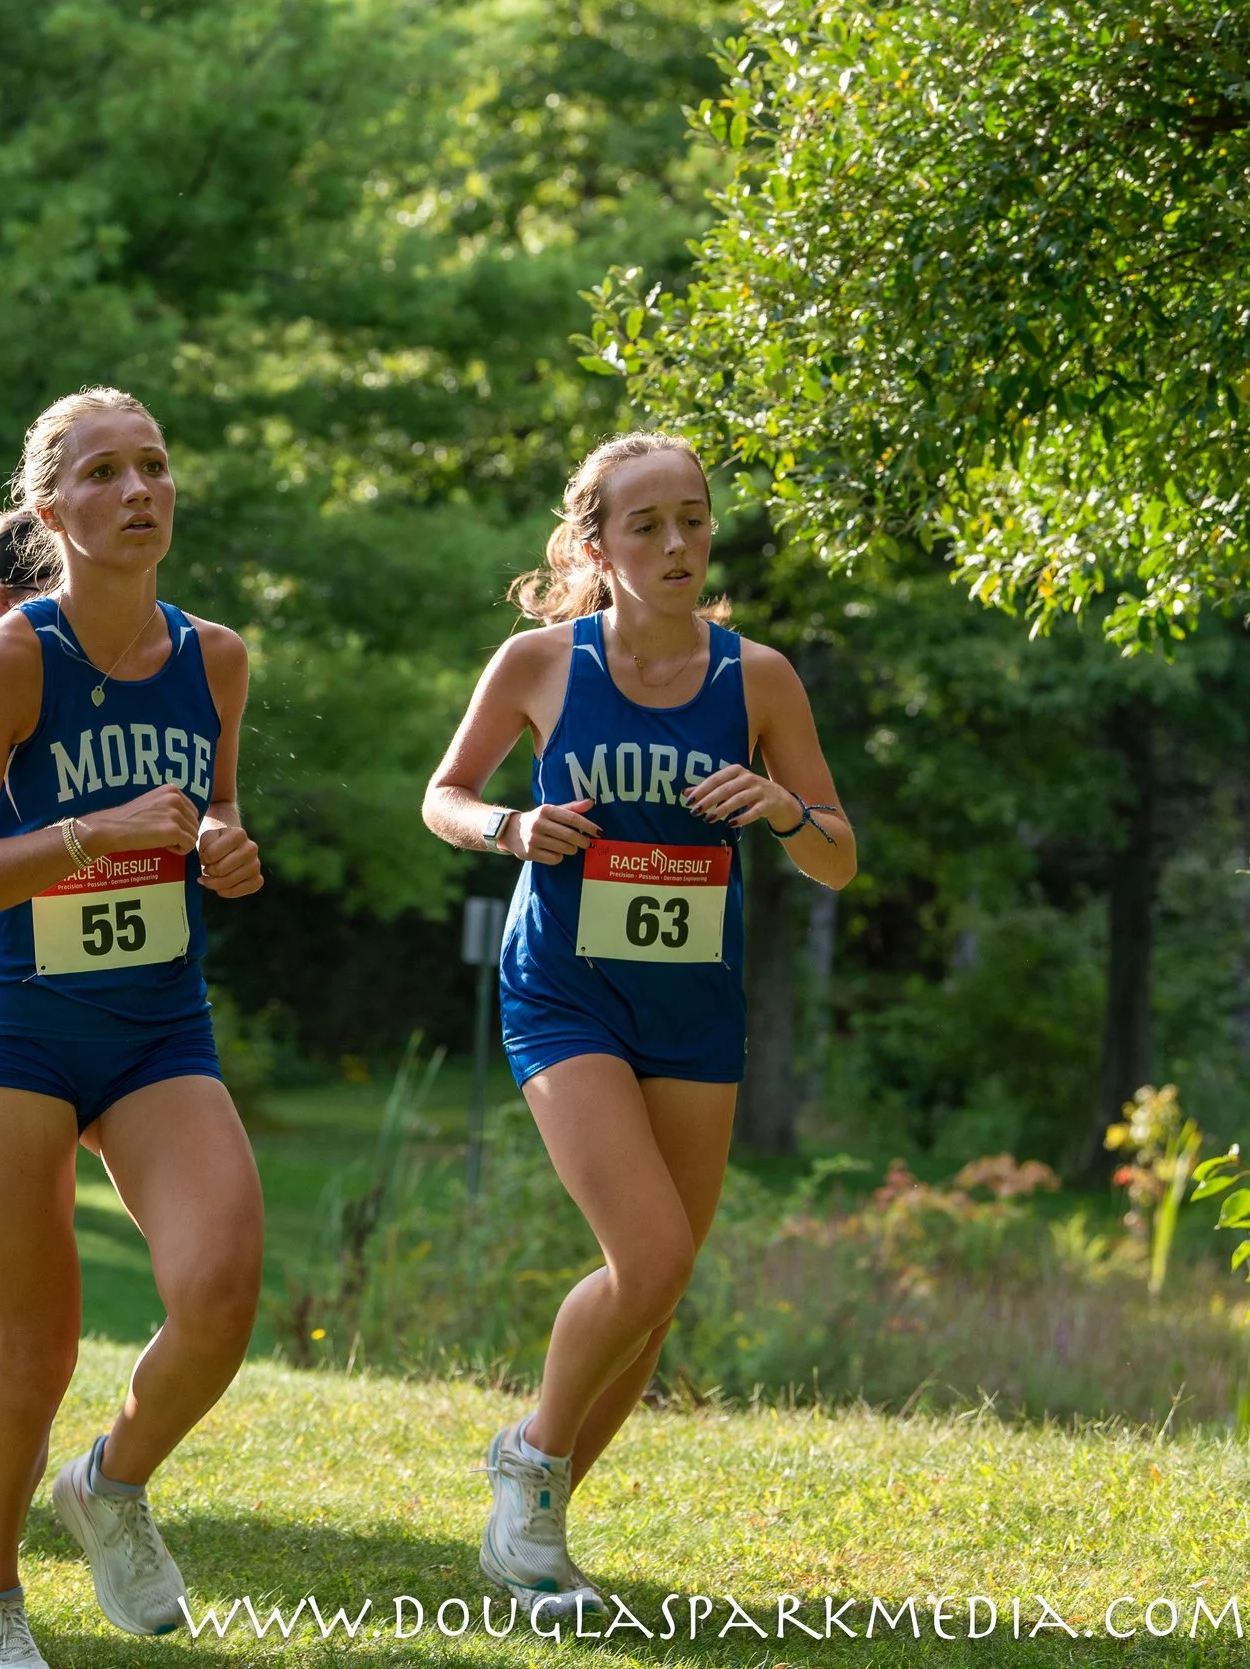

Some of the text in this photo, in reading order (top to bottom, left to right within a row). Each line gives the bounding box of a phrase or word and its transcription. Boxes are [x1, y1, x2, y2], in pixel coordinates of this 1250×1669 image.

[49, 723, 211, 803] MORSE
[564, 742, 732, 821] MORS
[63, 857, 161, 881] ACE RESULT
[87, 880, 107, 888] Passion
[130, 874, 158, 883] Engineering
[609, 871, 634, 879] Precision
[610, 855, 712, 874] RACE RESULT
[81, 899, 146, 956] 55
[626, 896, 690, 948] 63
